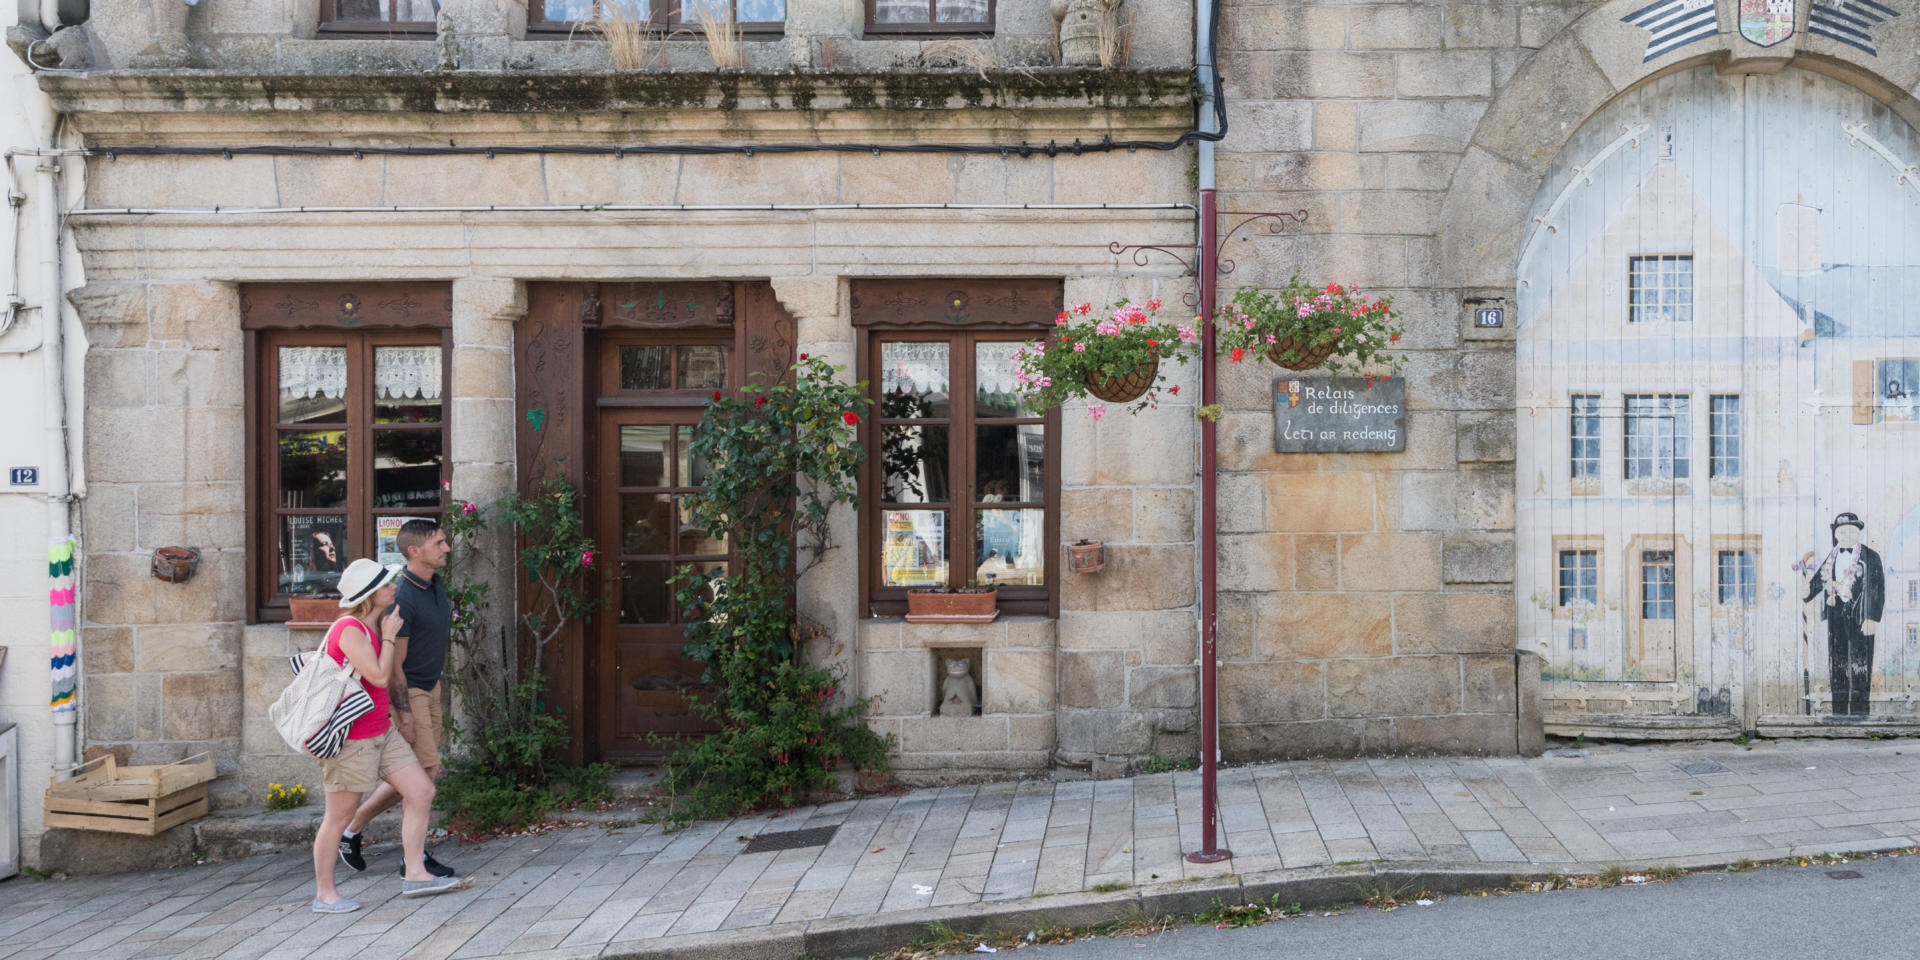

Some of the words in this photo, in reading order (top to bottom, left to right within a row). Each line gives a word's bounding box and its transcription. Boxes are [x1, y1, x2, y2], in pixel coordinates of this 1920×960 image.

[1481, 311, 1497, 325] 16
[1305, 385, 1355, 400] Relais
[1307, 400, 1323, 414] de
[1329, 400, 1399, 420] diligences
[16, 469, 33, 483] 12
[289, 516, 314, 525] LOUISE
[316, 515, 344, 524] MICHEL
